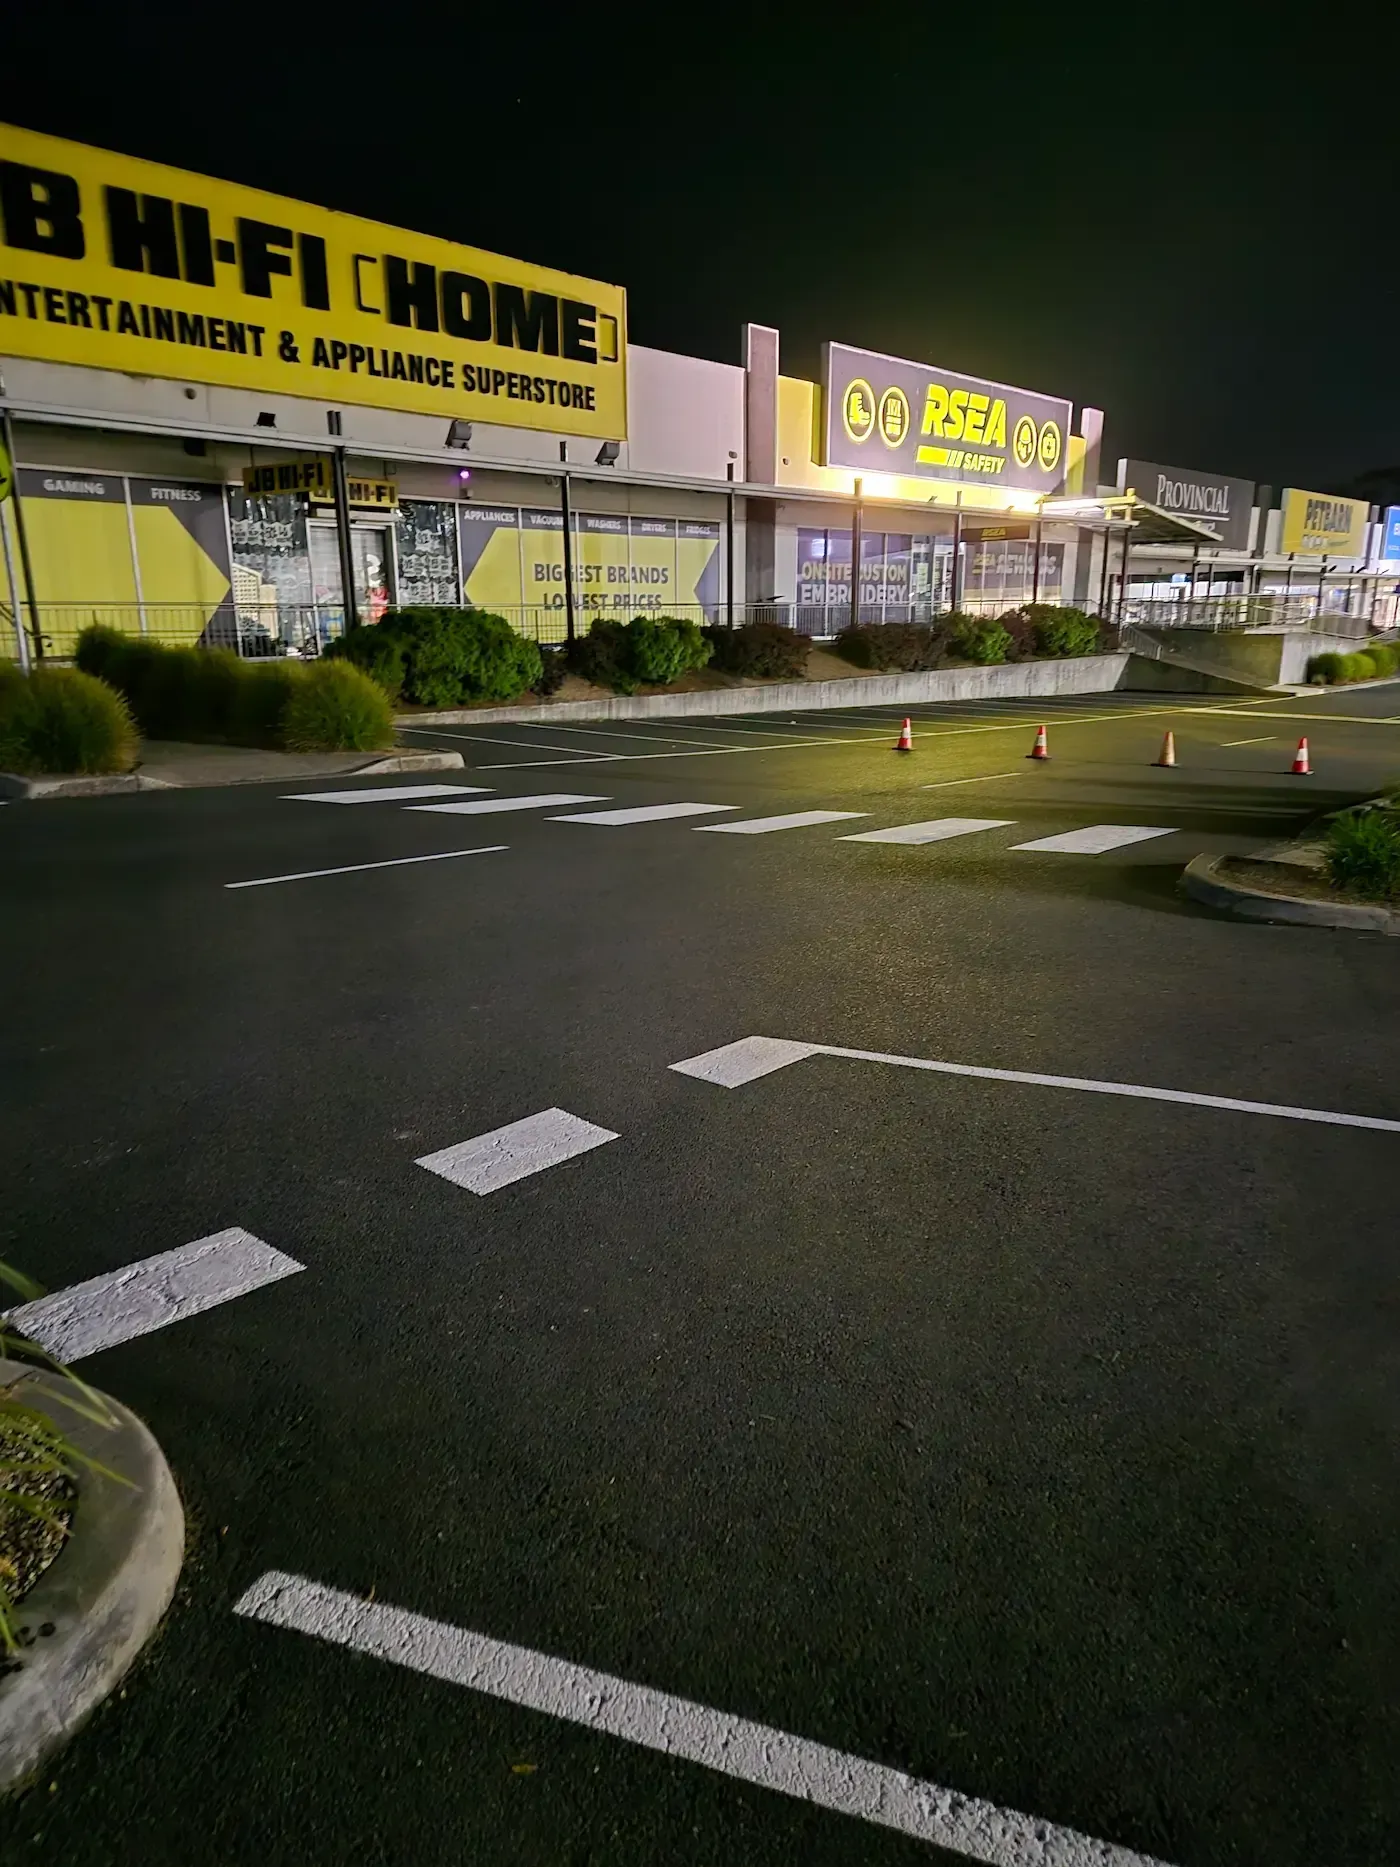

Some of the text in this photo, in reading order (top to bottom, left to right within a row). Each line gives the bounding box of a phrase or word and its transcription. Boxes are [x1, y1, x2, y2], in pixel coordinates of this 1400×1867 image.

[101, 184, 331, 312] HI-FI
[278, 330, 301, 363] &
[312, 337, 455, 389] APPLIANCE
[462, 364, 596, 412] SUPERSTORE
[921, 383, 1007, 448] RSEA
[963, 455, 1006, 474] SAFETY
[43, 478, 105, 495] GAMING
[248, 462, 324, 492] JB HI-FI
[150, 487, 202, 502] FITNESS
[348, 482, 396, 503] HI-FI
[1156, 474, 1230, 514] PROVINCIAL
[464, 509, 516, 523] APPLIANCES
[586, 519, 622, 531] WASHERS
[641, 523, 667, 533] DRYERS
[801, 561, 852, 581] ONSITE
[996, 554, 1057, 575] REWADS
[607, 565, 669, 585] BRANDS
[612, 593, 662, 611] PRICES
